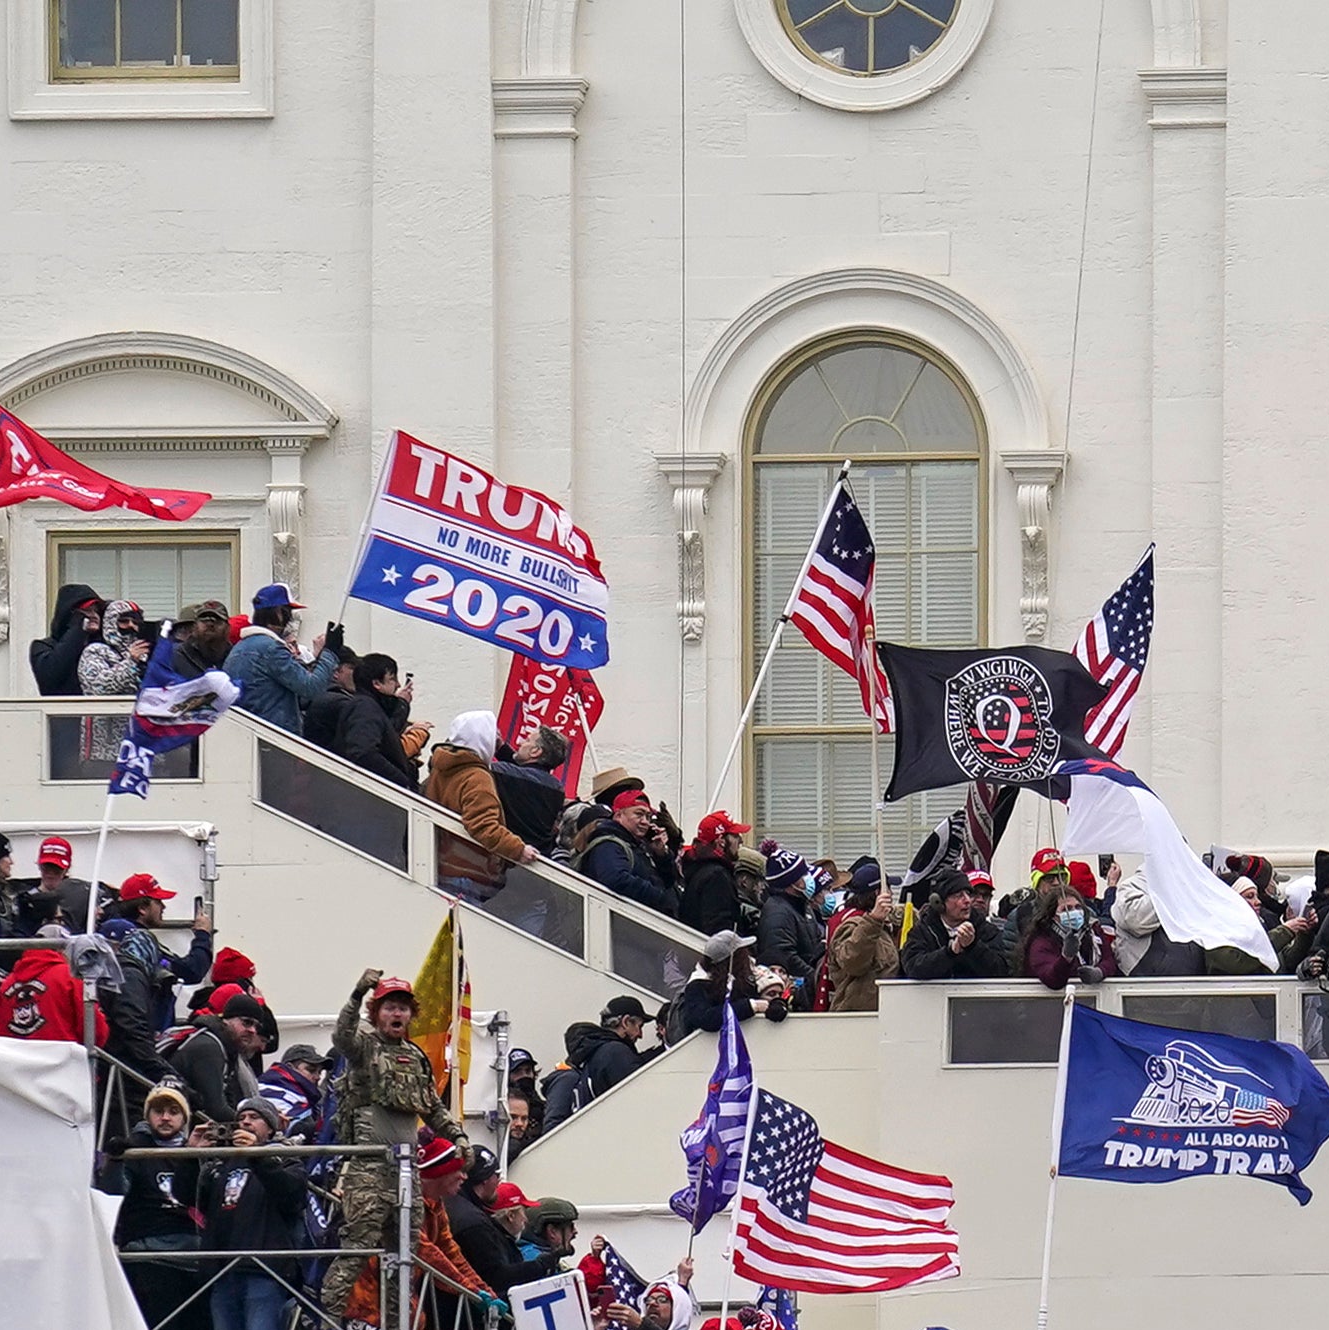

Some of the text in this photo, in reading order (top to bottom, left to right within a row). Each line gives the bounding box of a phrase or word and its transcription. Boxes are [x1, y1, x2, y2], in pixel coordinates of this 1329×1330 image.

[436, 526, 580, 594] NO MORE BULLSHIT
[403, 563, 573, 657] 2020
[949, 694, 966, 751] WHERE
[961, 750, 984, 777] WE
[976, 694, 1022, 757] Q
[1177, 1099, 1230, 1123] 2020
[1184, 1133, 1206, 1147] ALL
[1213, 1133, 1279, 1148] ABOARD
[1103, 1141, 1208, 1171] TRUMP
